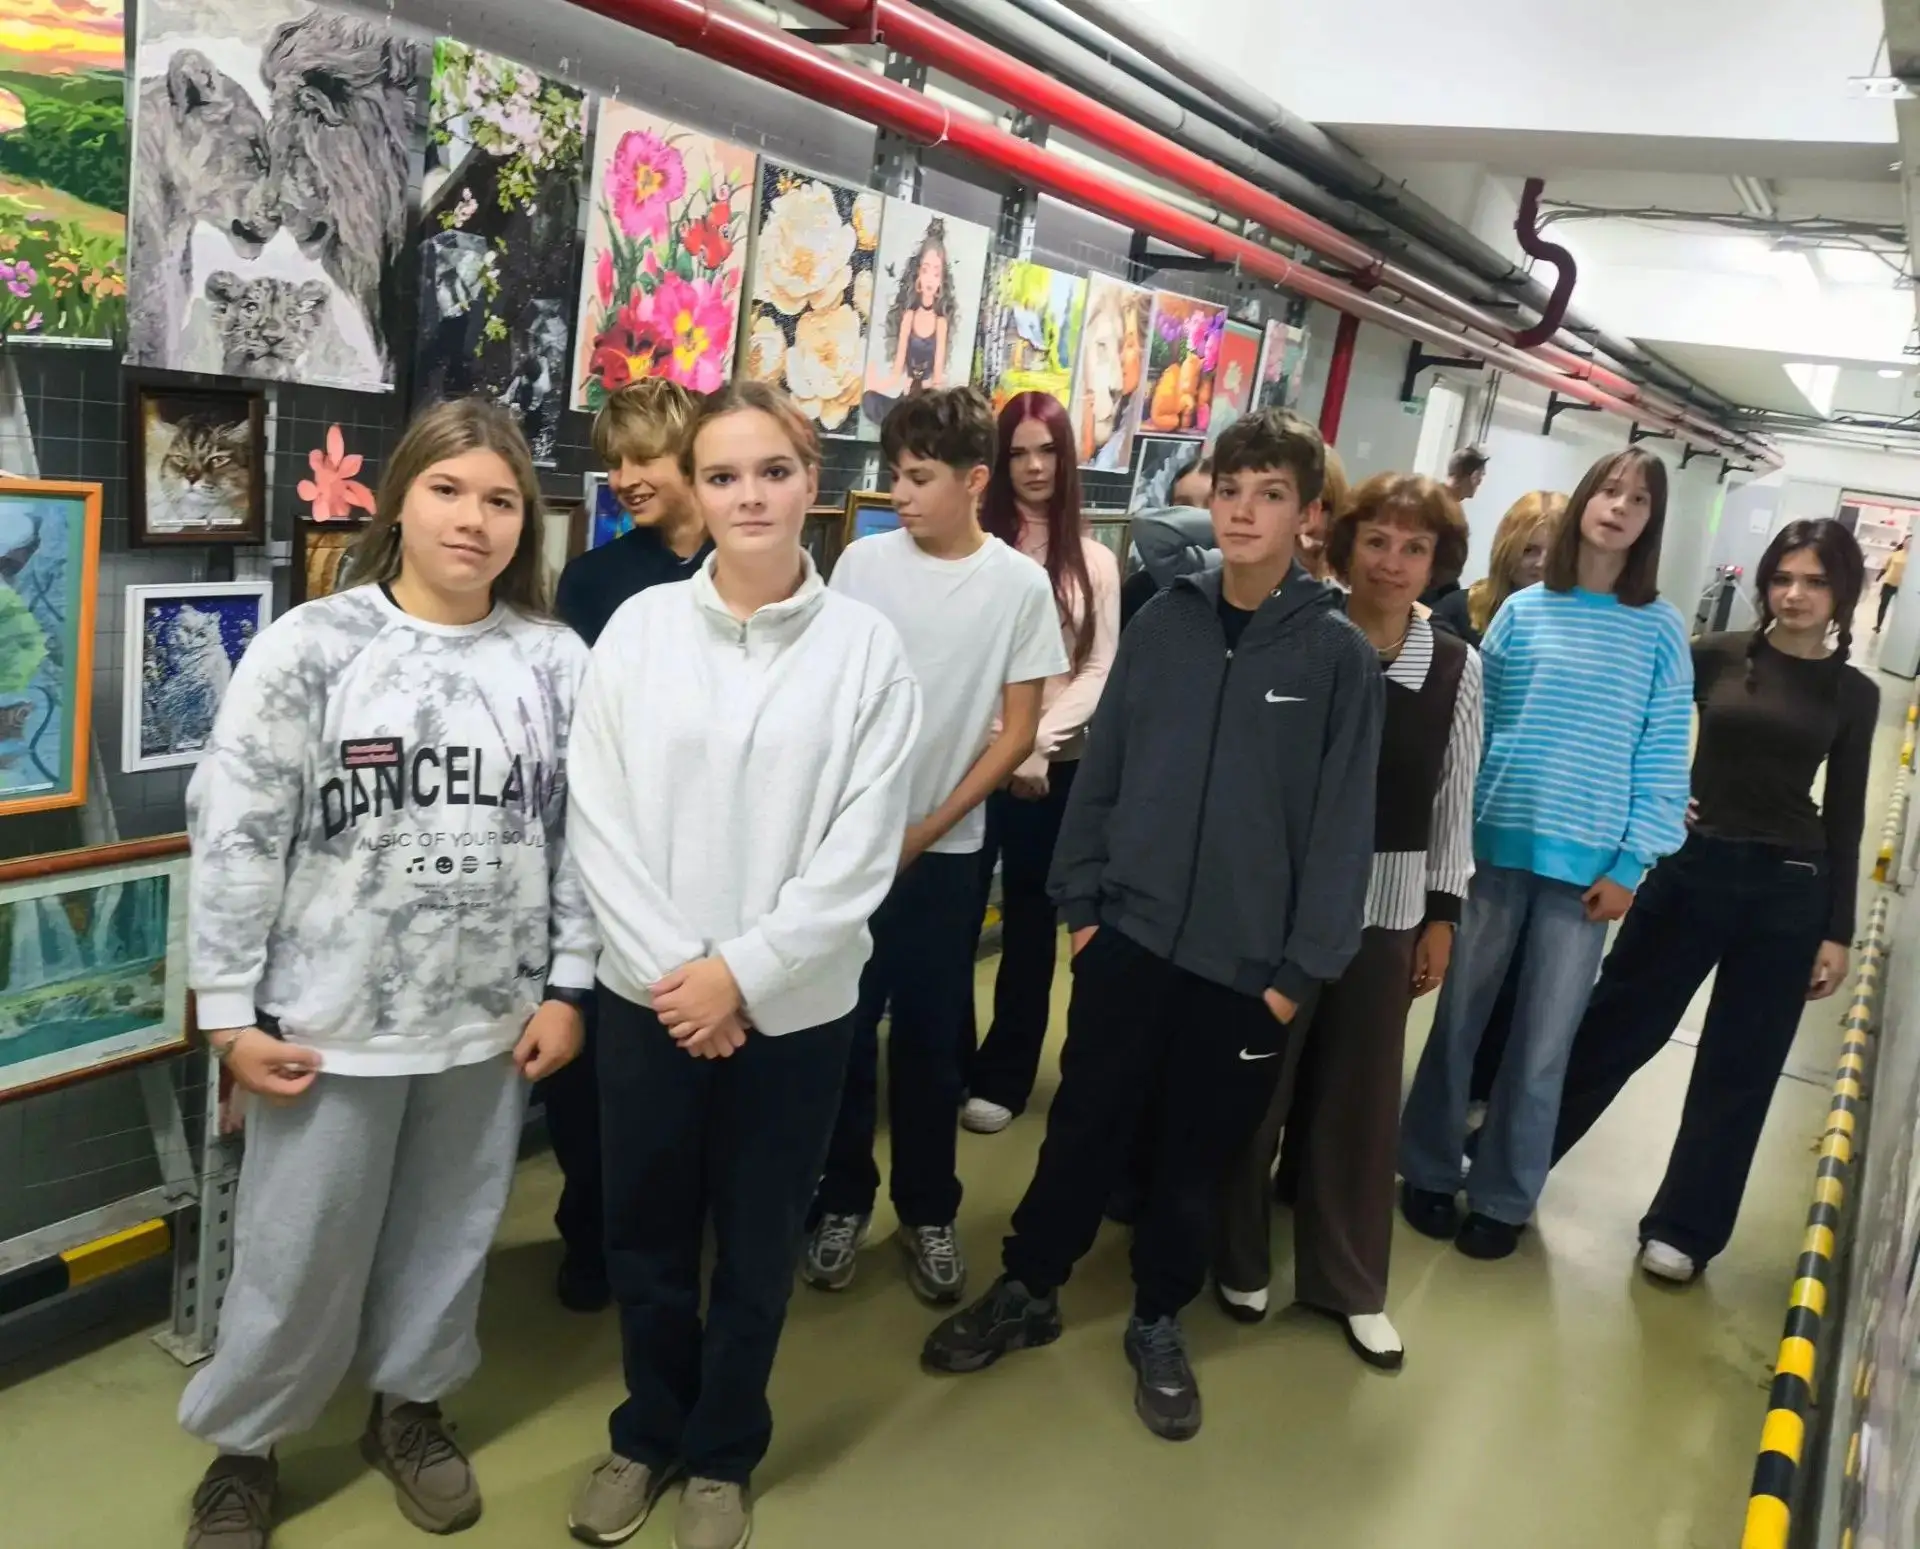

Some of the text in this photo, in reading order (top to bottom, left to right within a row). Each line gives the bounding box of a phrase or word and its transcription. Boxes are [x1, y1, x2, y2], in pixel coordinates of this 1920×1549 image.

[320, 746, 555, 841] DANCELAN
[358, 830, 546, 851] MUSIC OF YOUR SOUL
